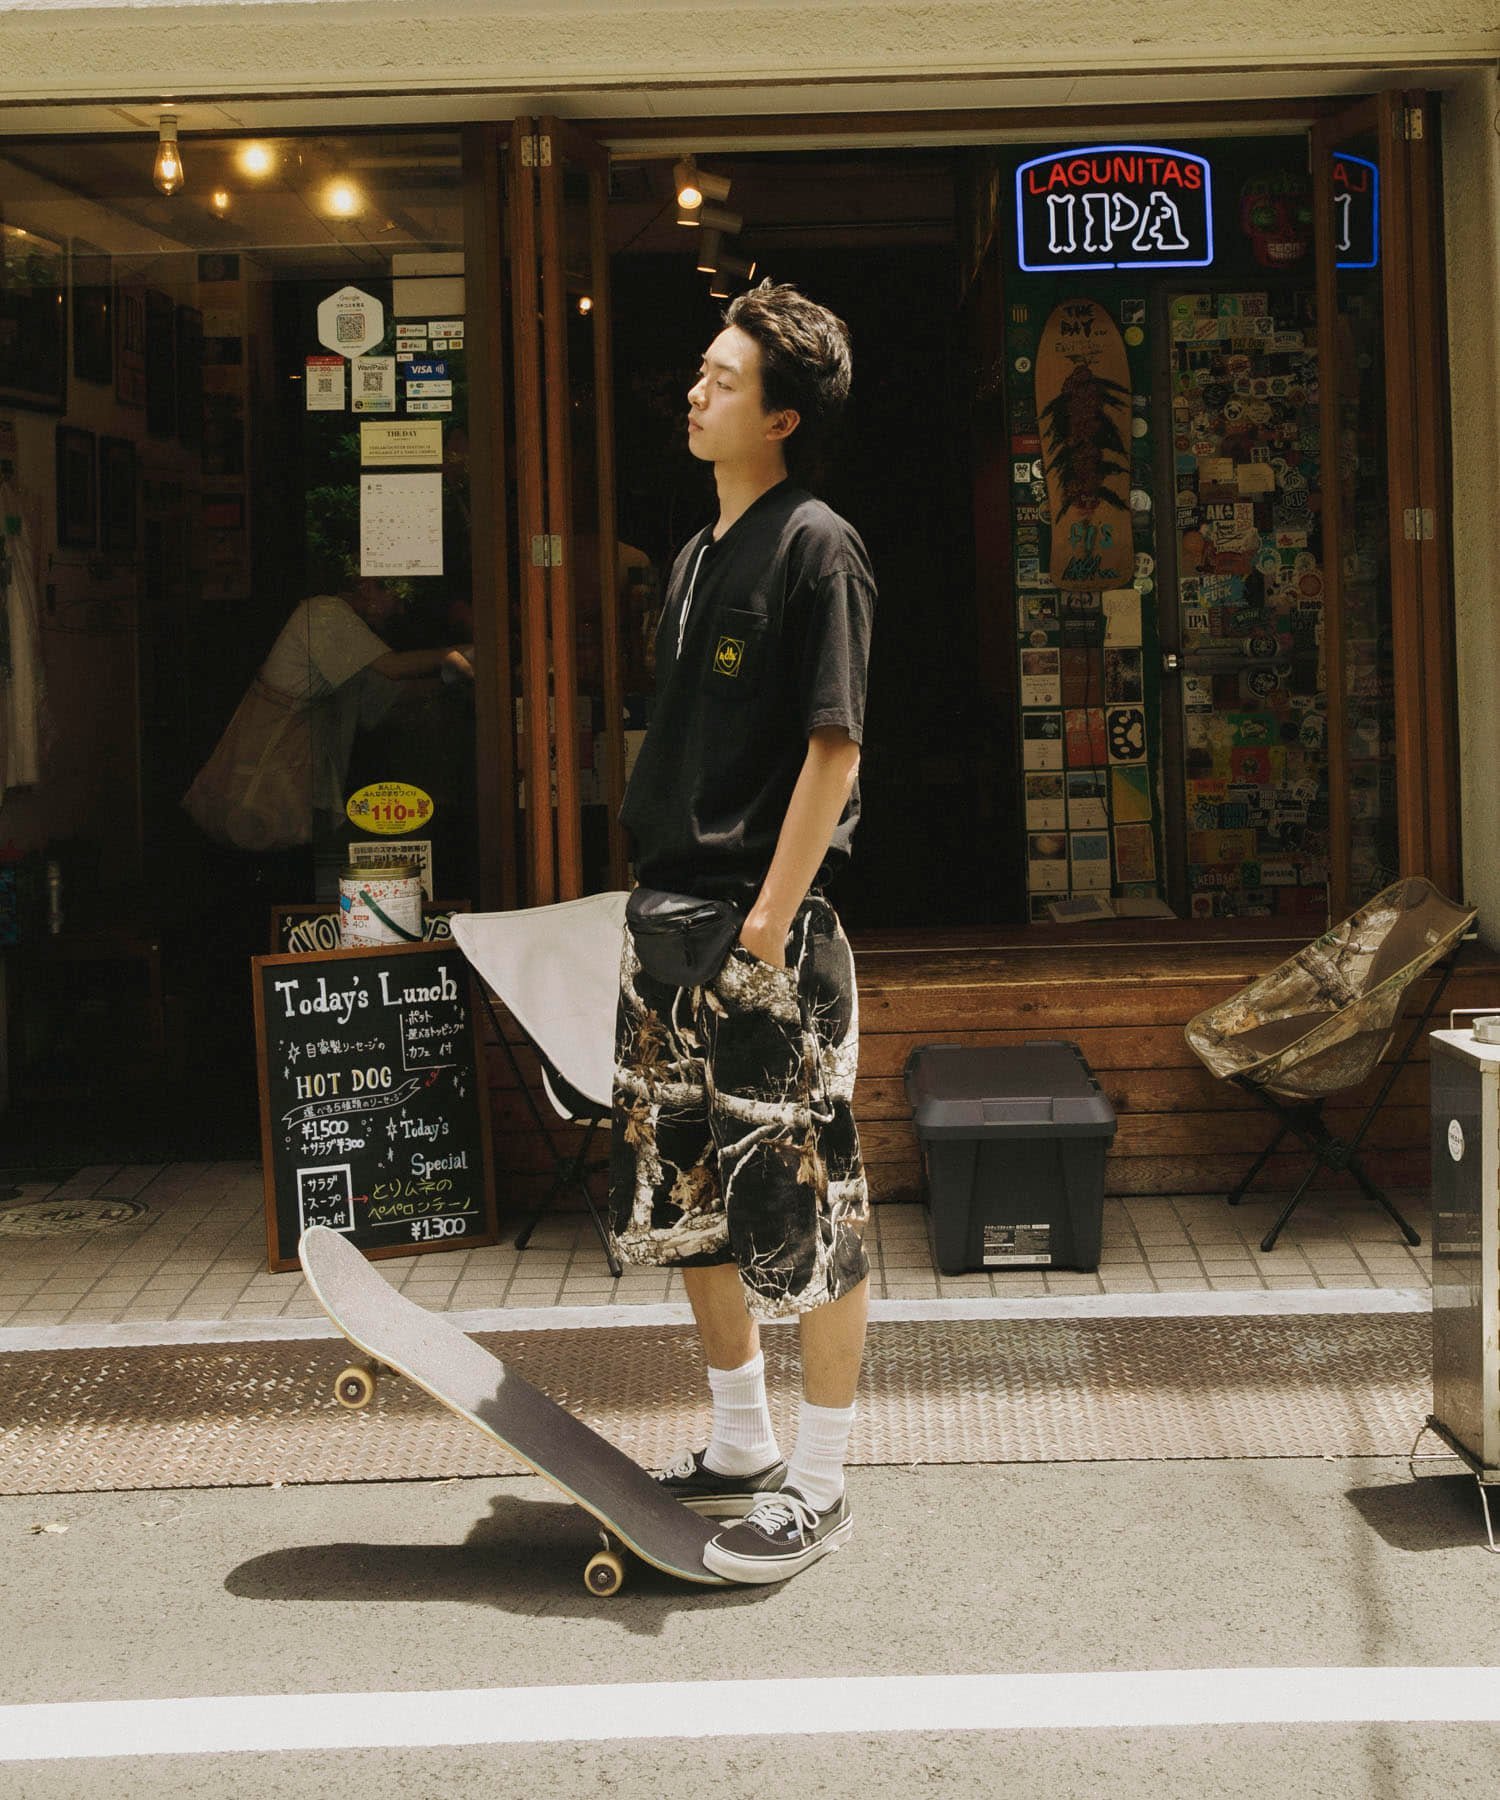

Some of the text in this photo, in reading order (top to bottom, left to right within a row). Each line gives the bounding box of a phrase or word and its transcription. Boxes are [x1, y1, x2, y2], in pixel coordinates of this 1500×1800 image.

[1028, 156, 1202, 194] LAGUNITAS
[1046, 191, 1190, 253] IPA
[410, 366, 433, 374] VISA
[274, 966, 458, 1024] Today's Lunch
[295, 1066, 392, 1100] HOT DOG
[400, 1116, 449, 1142] Today's
[411, 1151, 469, 1180] Special
